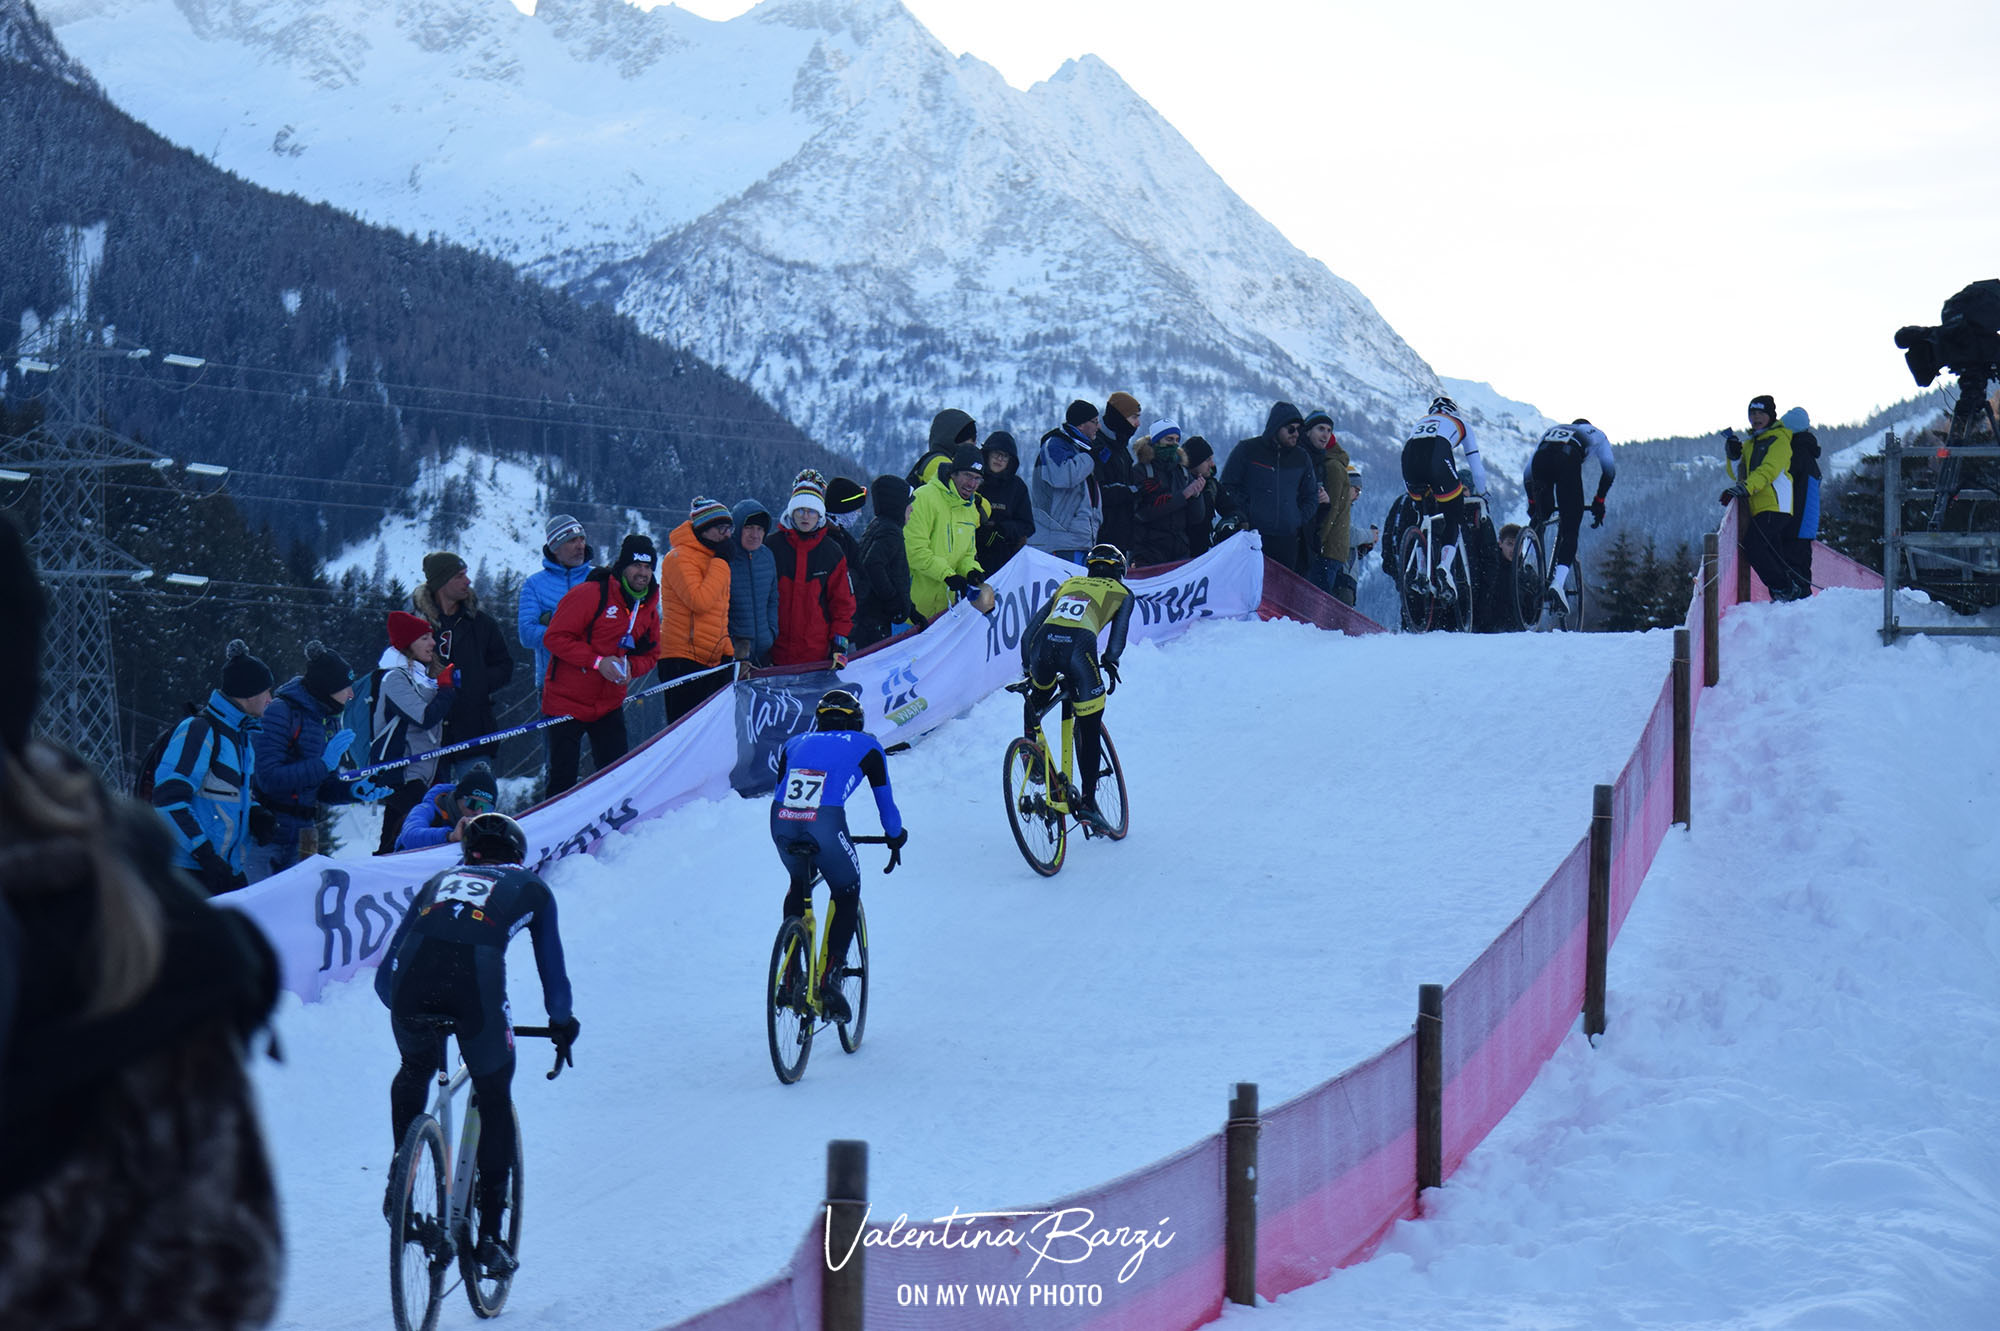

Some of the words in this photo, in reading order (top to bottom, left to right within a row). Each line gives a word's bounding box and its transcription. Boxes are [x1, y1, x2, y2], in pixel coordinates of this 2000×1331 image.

[1414, 424, 1438, 435] 36
[1055, 602, 1085, 616] 40
[787, 778, 823, 801] 37
[440, 879, 490, 897] 49
